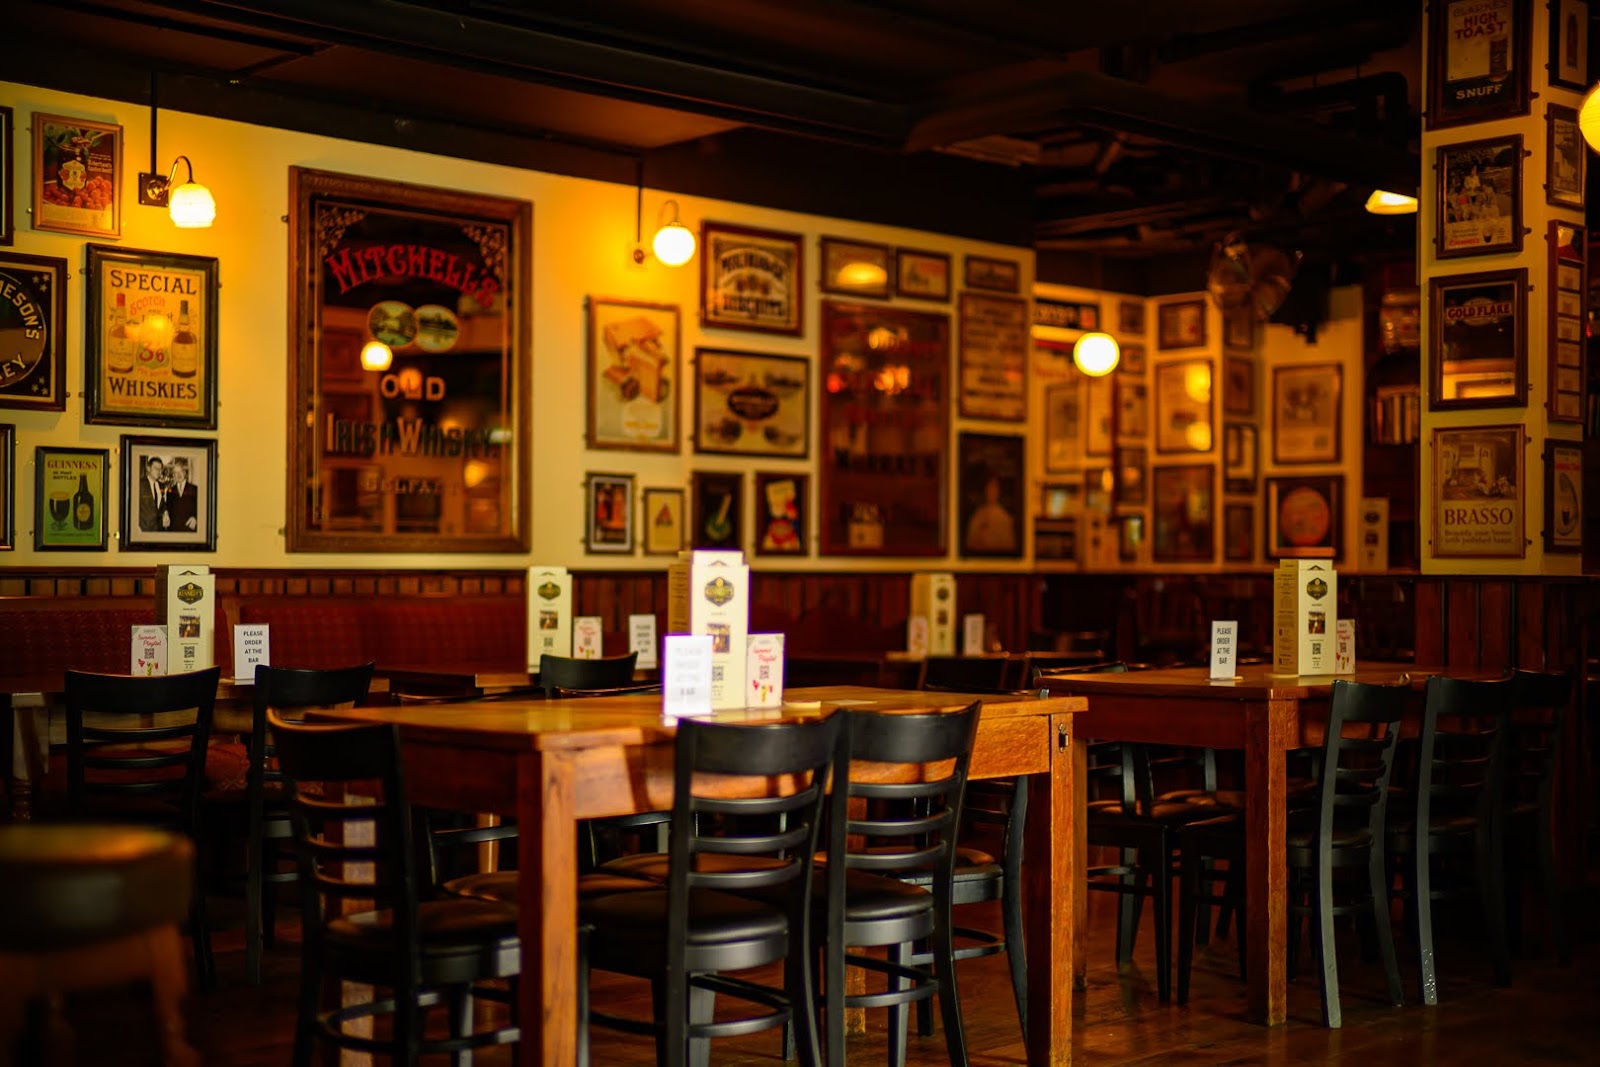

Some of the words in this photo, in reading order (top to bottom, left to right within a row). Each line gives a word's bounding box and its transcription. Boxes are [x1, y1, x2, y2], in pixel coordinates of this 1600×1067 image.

[1464, 12, 1497, 28] HIGH
[1455, 21, 1507, 40] TOAST
[1456, 84, 1503, 100] SNUFF
[110, 269, 197, 296] SPECIAL
[325, 244, 500, 307] MITCHELL'S
[130, 296, 165, 316] SCOTCH
[1448, 308, 1475, 319] GOLD
[1477, 303, 1511, 317] FLAKE
[109, 377, 197, 399] WHISKIES
[381, 374, 446, 401] OLD
[327, 413, 394, 455] IRISH
[47, 459, 98, 470] GUINNESS
[1444, 507, 1514, 526] BRASSO
[1216, 627, 1232, 635] PLEASE
[1216, 637, 1230, 645] ORDER
[1216, 647, 1223, 655] AT
[1223, 647, 1231, 655] THE
[1219, 657, 1228, 665] BAR
